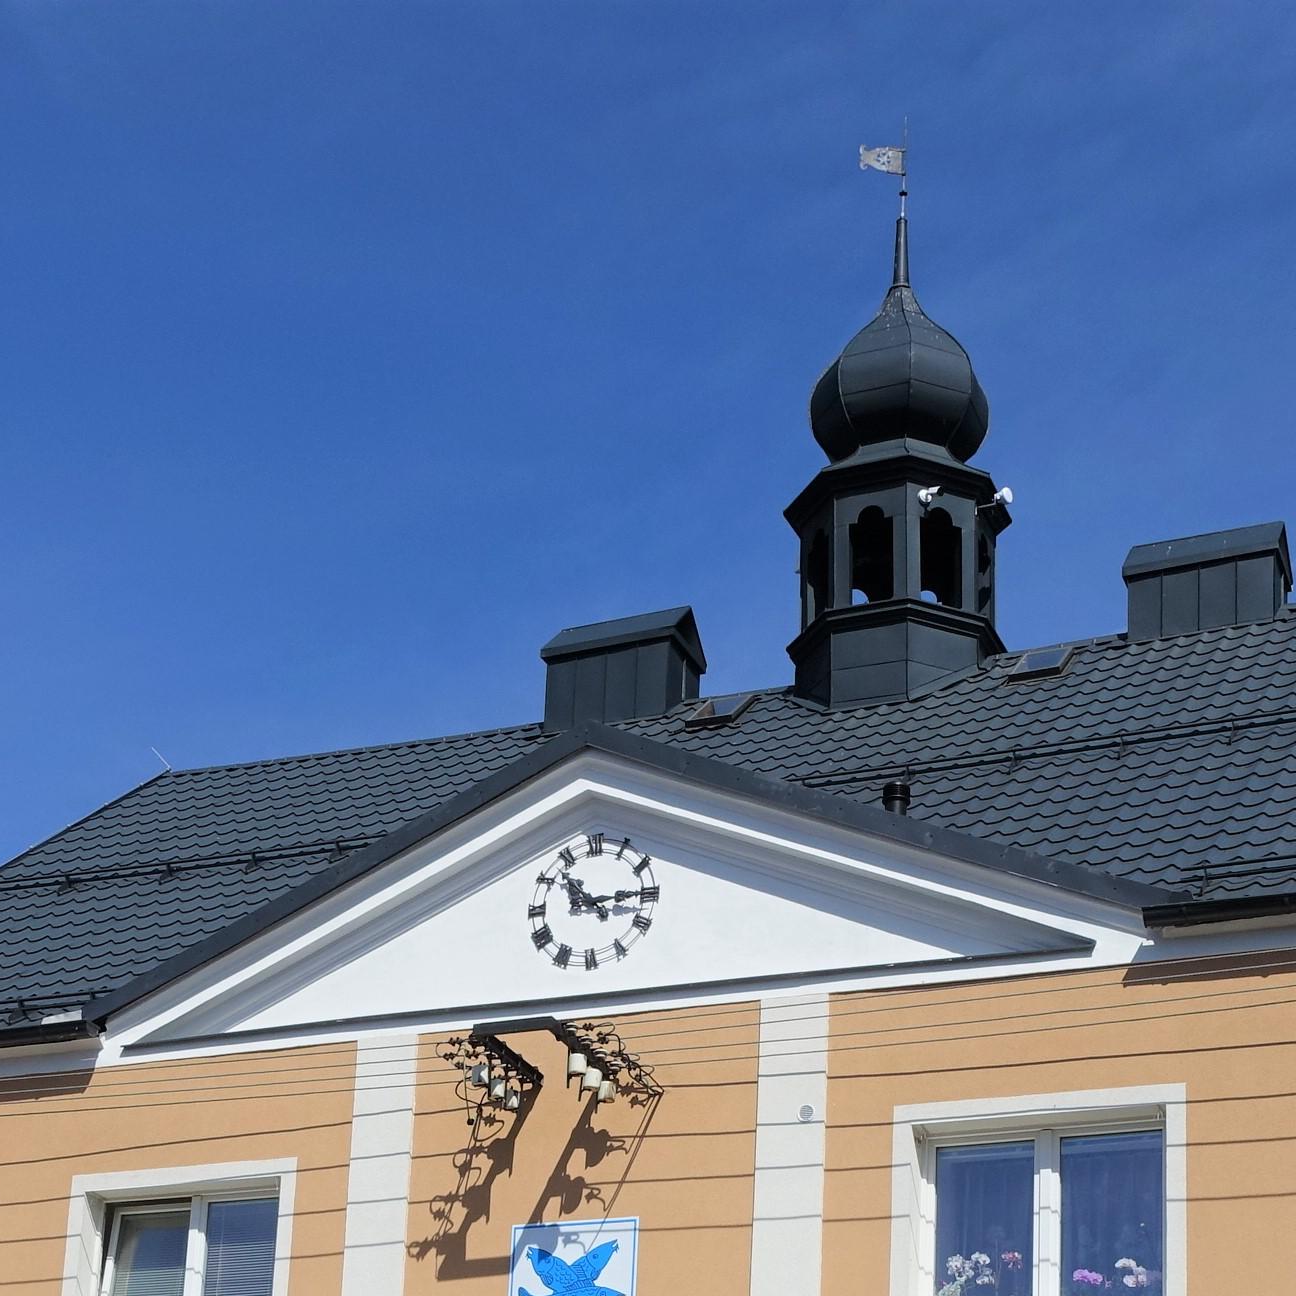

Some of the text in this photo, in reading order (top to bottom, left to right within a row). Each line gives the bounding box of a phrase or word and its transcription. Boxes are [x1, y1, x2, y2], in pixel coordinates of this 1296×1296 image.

[557, 845, 576, 870] XI
[586, 833, 604, 858] XII
[615, 837, 630, 861] I
[632, 853, 651, 878] II
[535, 870, 555, 891] X
[640, 884, 660, 905] III
[528, 900, 546, 920] IX
[531, 924, 553, 951] VIII
[552, 943, 572, 970] VII
[584, 948, 599, 971] VI
[614, 938, 628, 962] V
